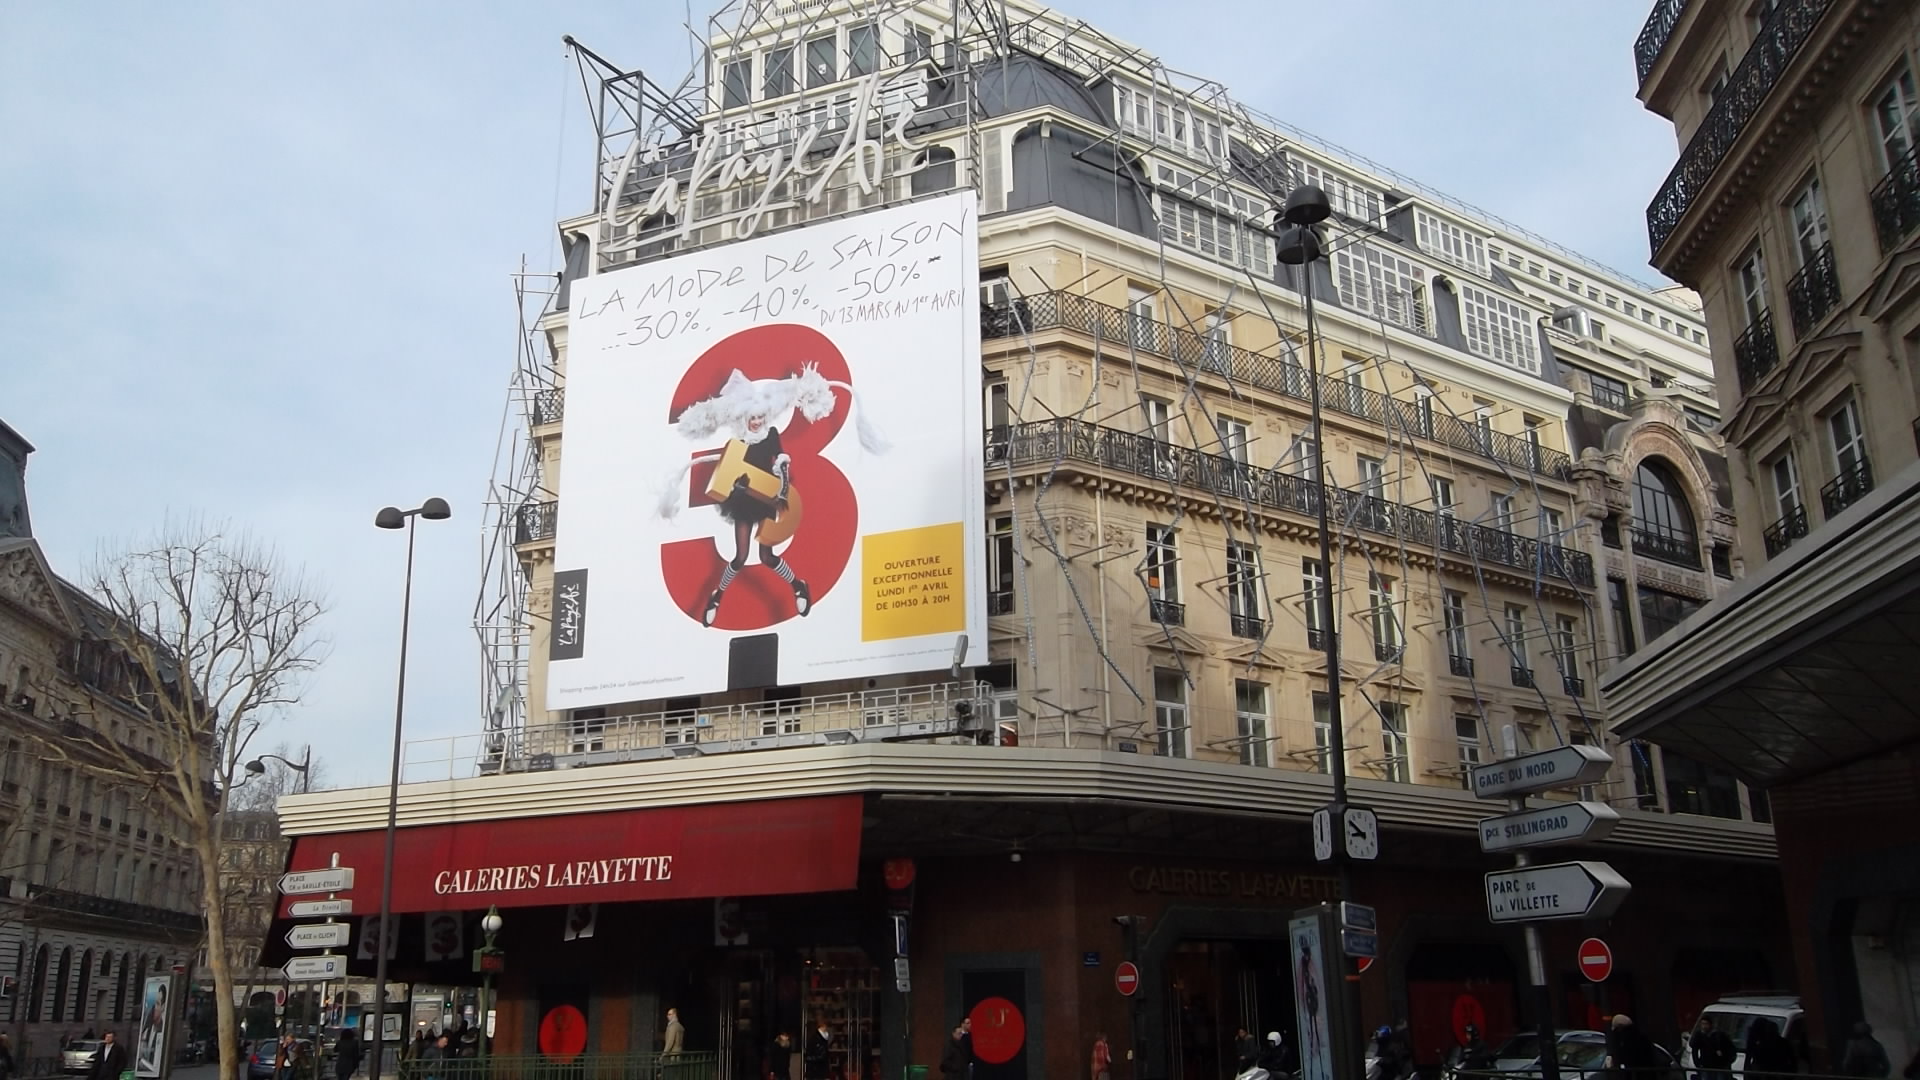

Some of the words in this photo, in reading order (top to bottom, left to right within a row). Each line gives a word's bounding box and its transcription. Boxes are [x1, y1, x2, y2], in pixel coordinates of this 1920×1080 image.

[579, 289, 626, 320] LA
[820, 309, 836, 327] DU
[839, 306, 854, 325] 13
[856, 300, 892, 322] MARS
[894, 299, 910, 318] AU
[884, 555, 941, 571] OUVERTURE
[873, 567, 953, 585] EXCEPTIONNELLE
[877, 586, 905, 598] LUNDI
[922, 581, 949, 592] AVRIL
[876, 601, 888, 611] DE
[892, 598, 918, 609] 10H30
[922, 595, 929, 605] À
[933, 594, 951, 604] 20H
[1479, 773, 1505, 788] GARE
[1508, 768, 1522, 782] DU
[1526, 761, 1556, 778] NORD
[1504, 816, 1568, 839] STALINGRAD
[434, 864, 541, 895] GALERIES
[545, 855, 673, 888] LAFAYETTE
[1128, 866, 1231, 895] GALERIES
[1492, 880, 1520, 895] PARC
[1526, 881, 1536, 891] DE
[1495, 904, 1504, 913] LA
[1509, 895, 1559, 912] VILLETTE
